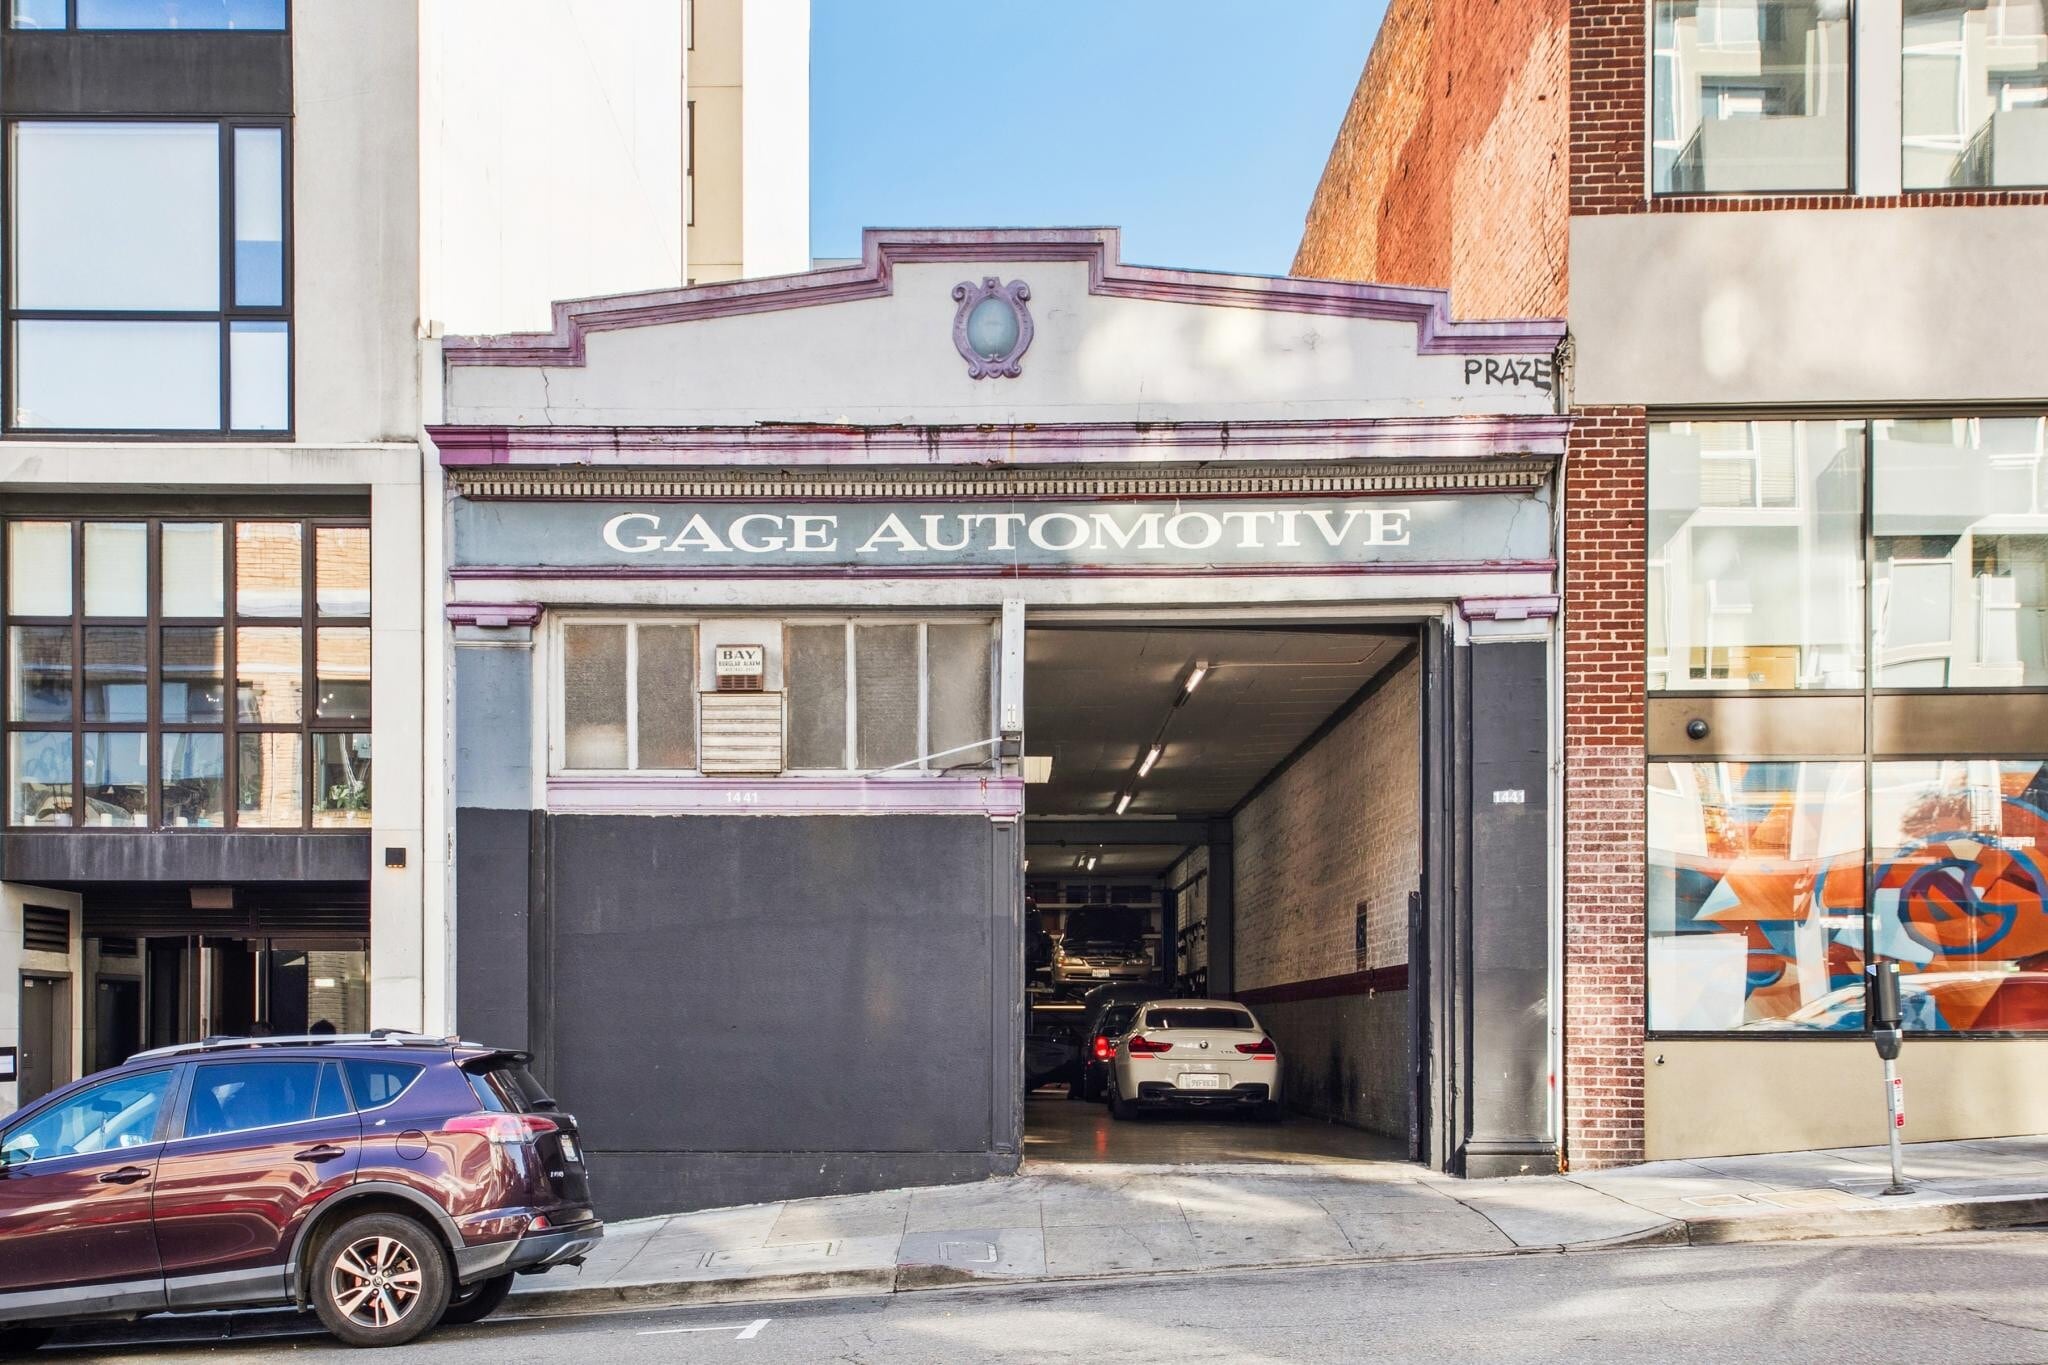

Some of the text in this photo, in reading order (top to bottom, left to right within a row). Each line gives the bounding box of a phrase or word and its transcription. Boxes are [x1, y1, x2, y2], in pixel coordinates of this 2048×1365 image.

[1465, 358, 1552, 390] PRAZE
[603, 508, 1411, 553] GAGE AUTOMOTIVE
[723, 650, 755, 659] BAY
[725, 791, 758, 803] 1441
